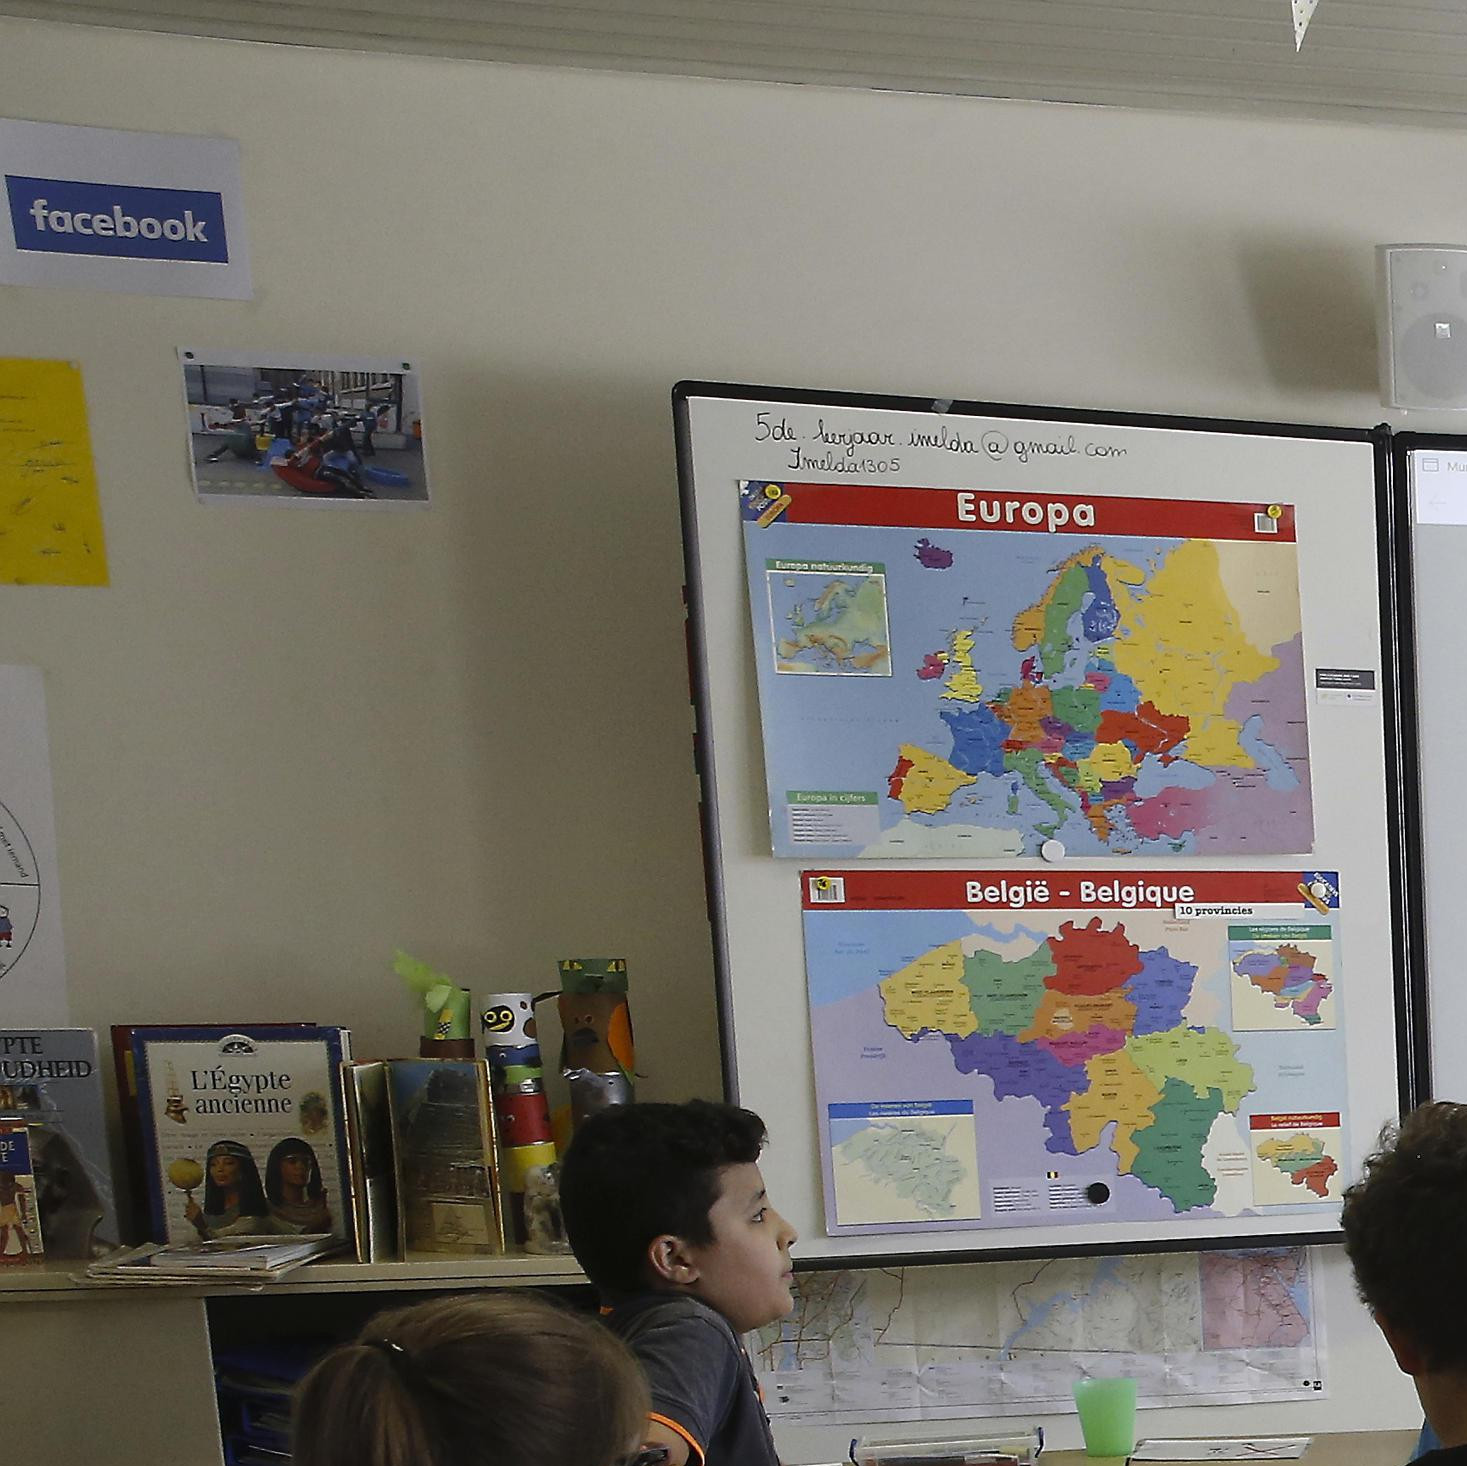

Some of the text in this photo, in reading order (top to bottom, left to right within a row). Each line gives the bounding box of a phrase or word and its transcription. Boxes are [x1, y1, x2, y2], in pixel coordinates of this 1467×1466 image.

[29, 199, 208, 242] facebook
[957, 492, 1095, 533] Europa
[966, 880, 1050, 908] België
[1080, 879, 1194, 908] Belgique
[1180, 906, 1253, 919] 10 provincies
[0, 1036, 43, 1055] PTE
[191, 1065, 291, 1094] L'Égypte
[195, 1093, 292, 1114] ancienne
